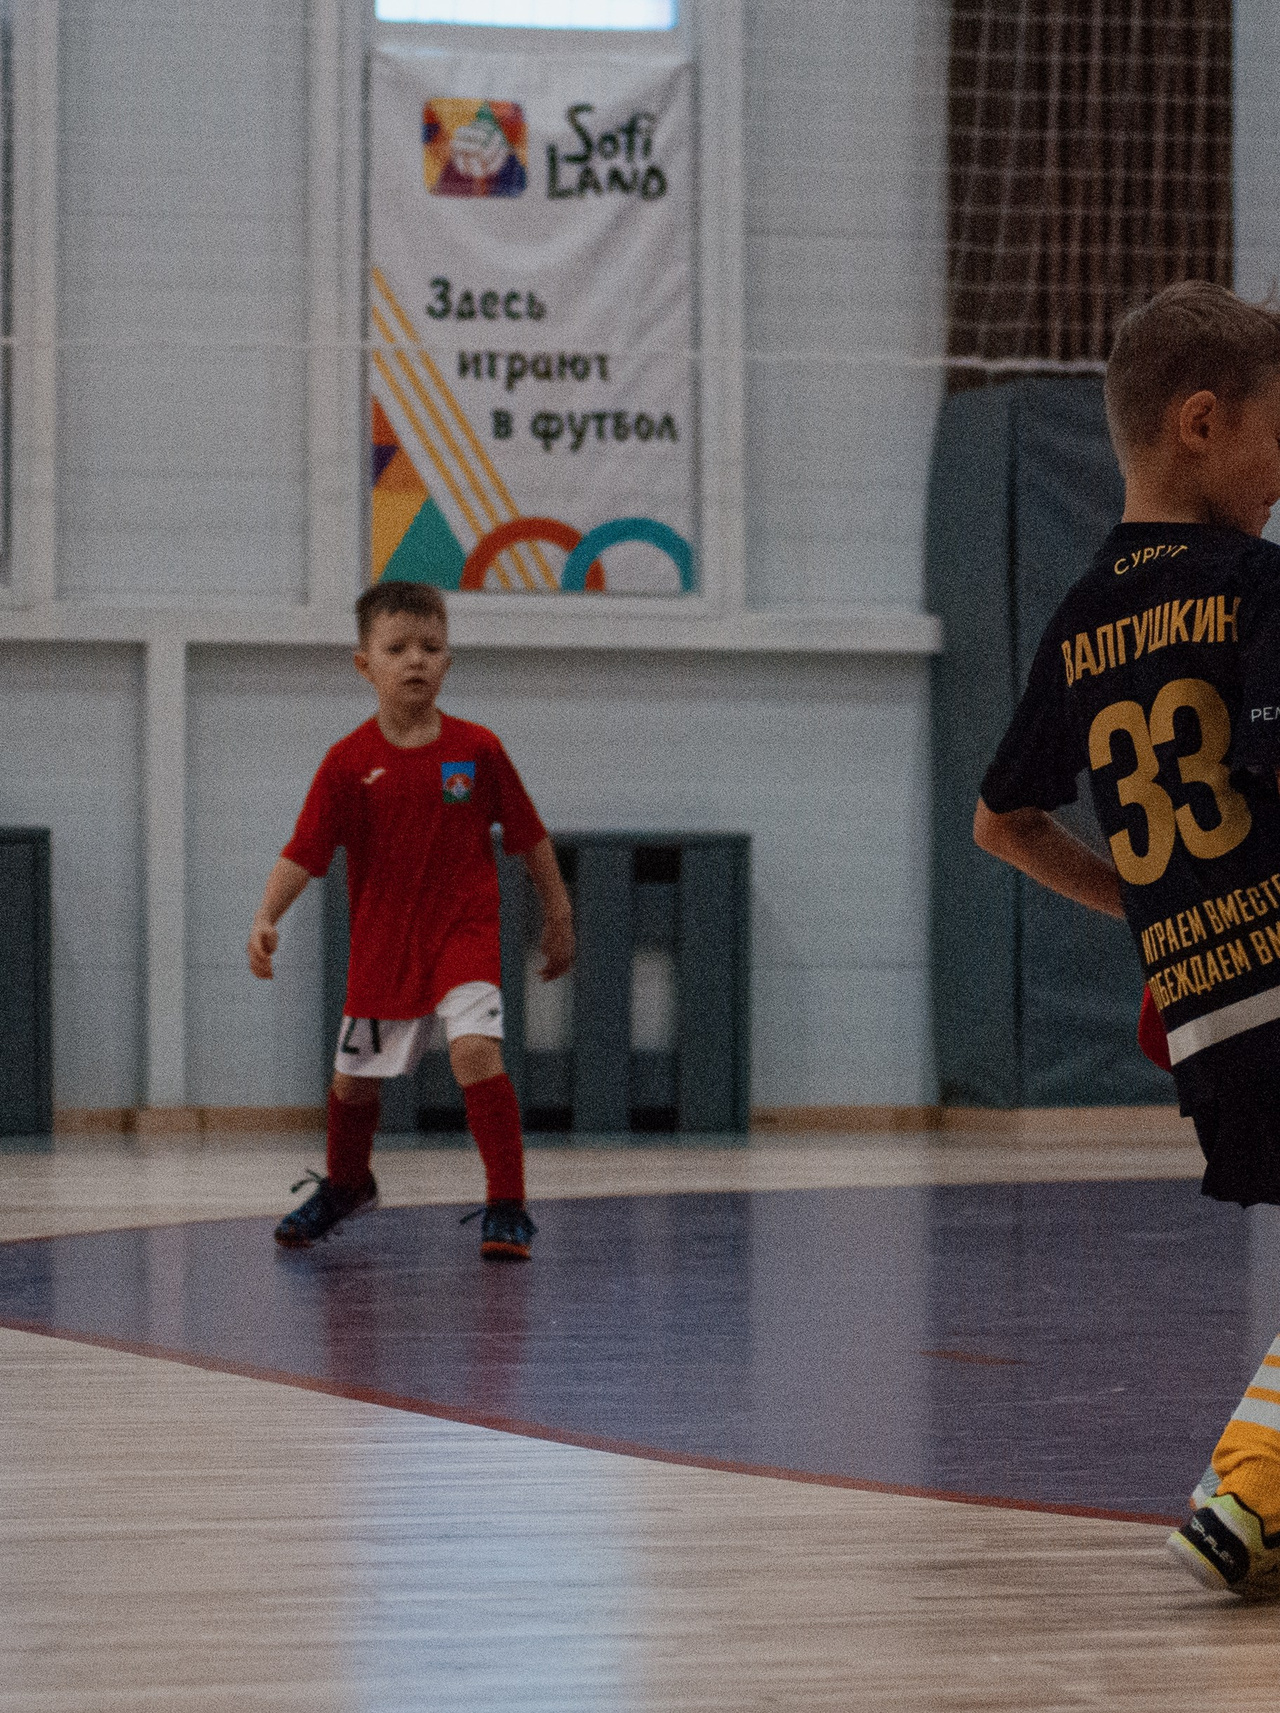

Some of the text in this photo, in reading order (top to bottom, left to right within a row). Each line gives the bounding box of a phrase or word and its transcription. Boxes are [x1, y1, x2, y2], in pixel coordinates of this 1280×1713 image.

[564, 103, 656, 165] Sofi
[546, 143, 667, 200] LAND
[426, 275, 548, 321] Здесь
[456, 351, 610, 392] играют
[491, 409, 679, 453] в футбол
[1113, 544, 1189, 575] СУРГУТ
[1061, 594, 1242, 688] ВАЛГУШКИН
[1088, 677, 1252, 886] 33
[1141, 905, 1208, 966] ИГРАЕМ
